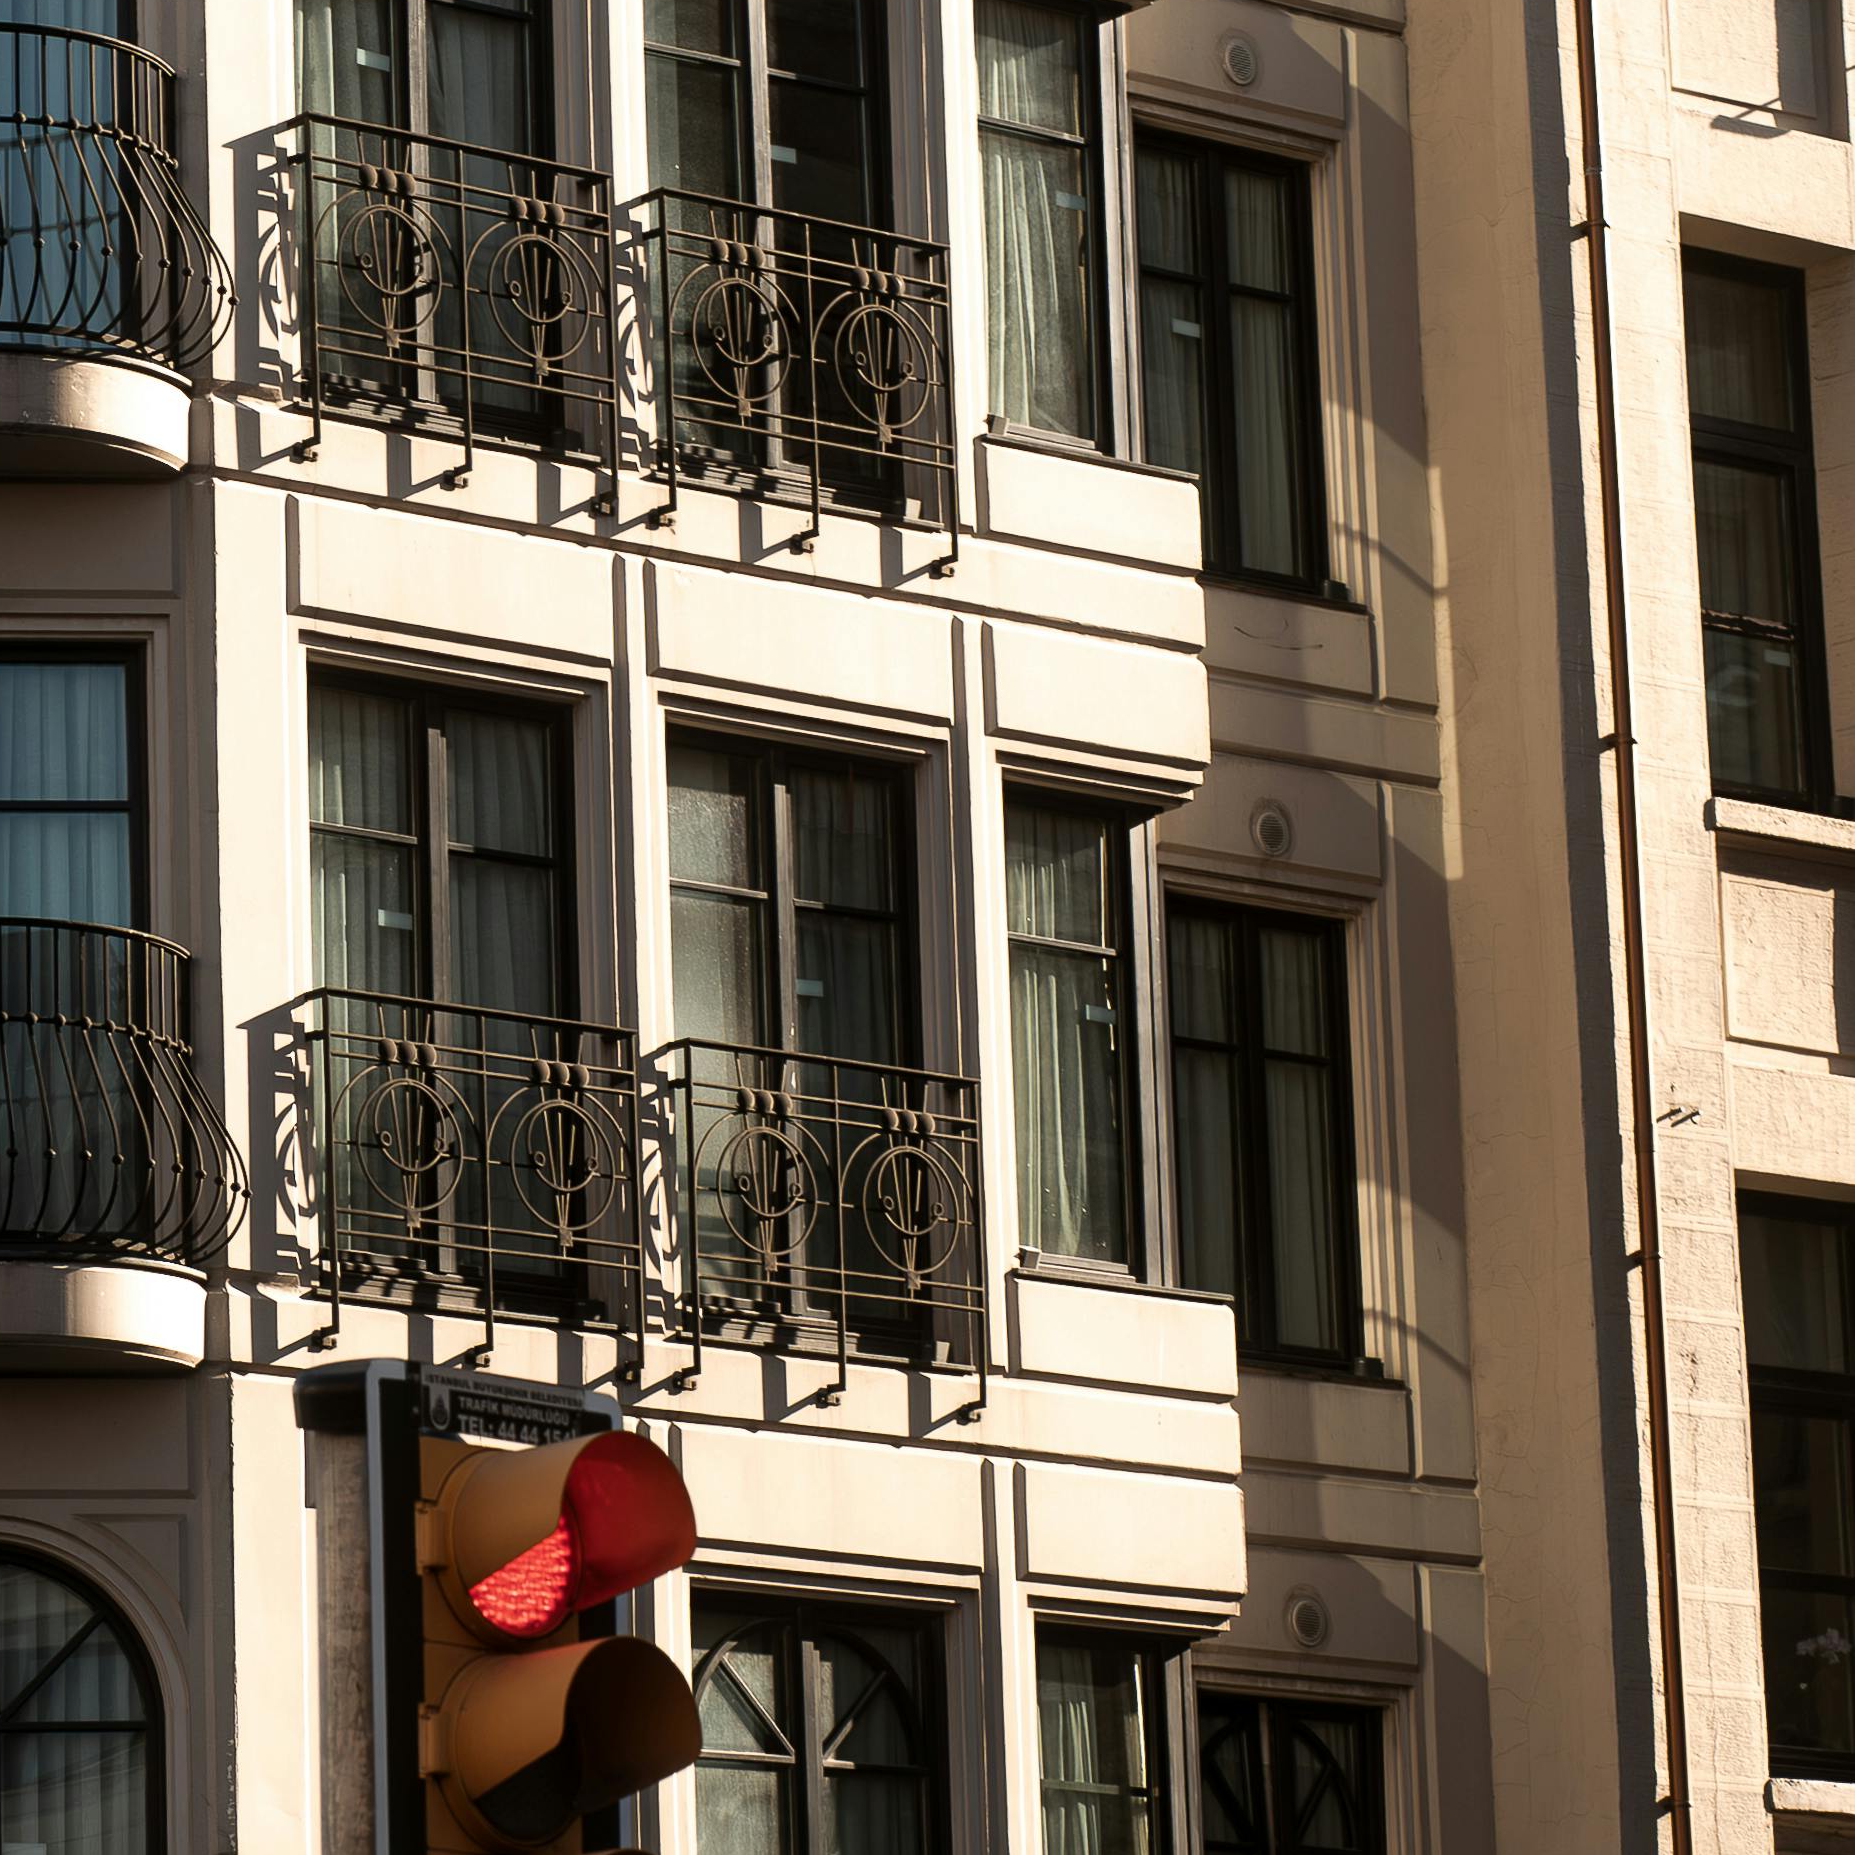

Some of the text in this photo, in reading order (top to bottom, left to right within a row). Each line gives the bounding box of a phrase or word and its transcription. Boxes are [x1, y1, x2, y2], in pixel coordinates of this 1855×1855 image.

[457, 1414, 494, 1437] TEL:
[498, 1421, 516, 1440] 44
[520, 1424, 539, 1444] 44
